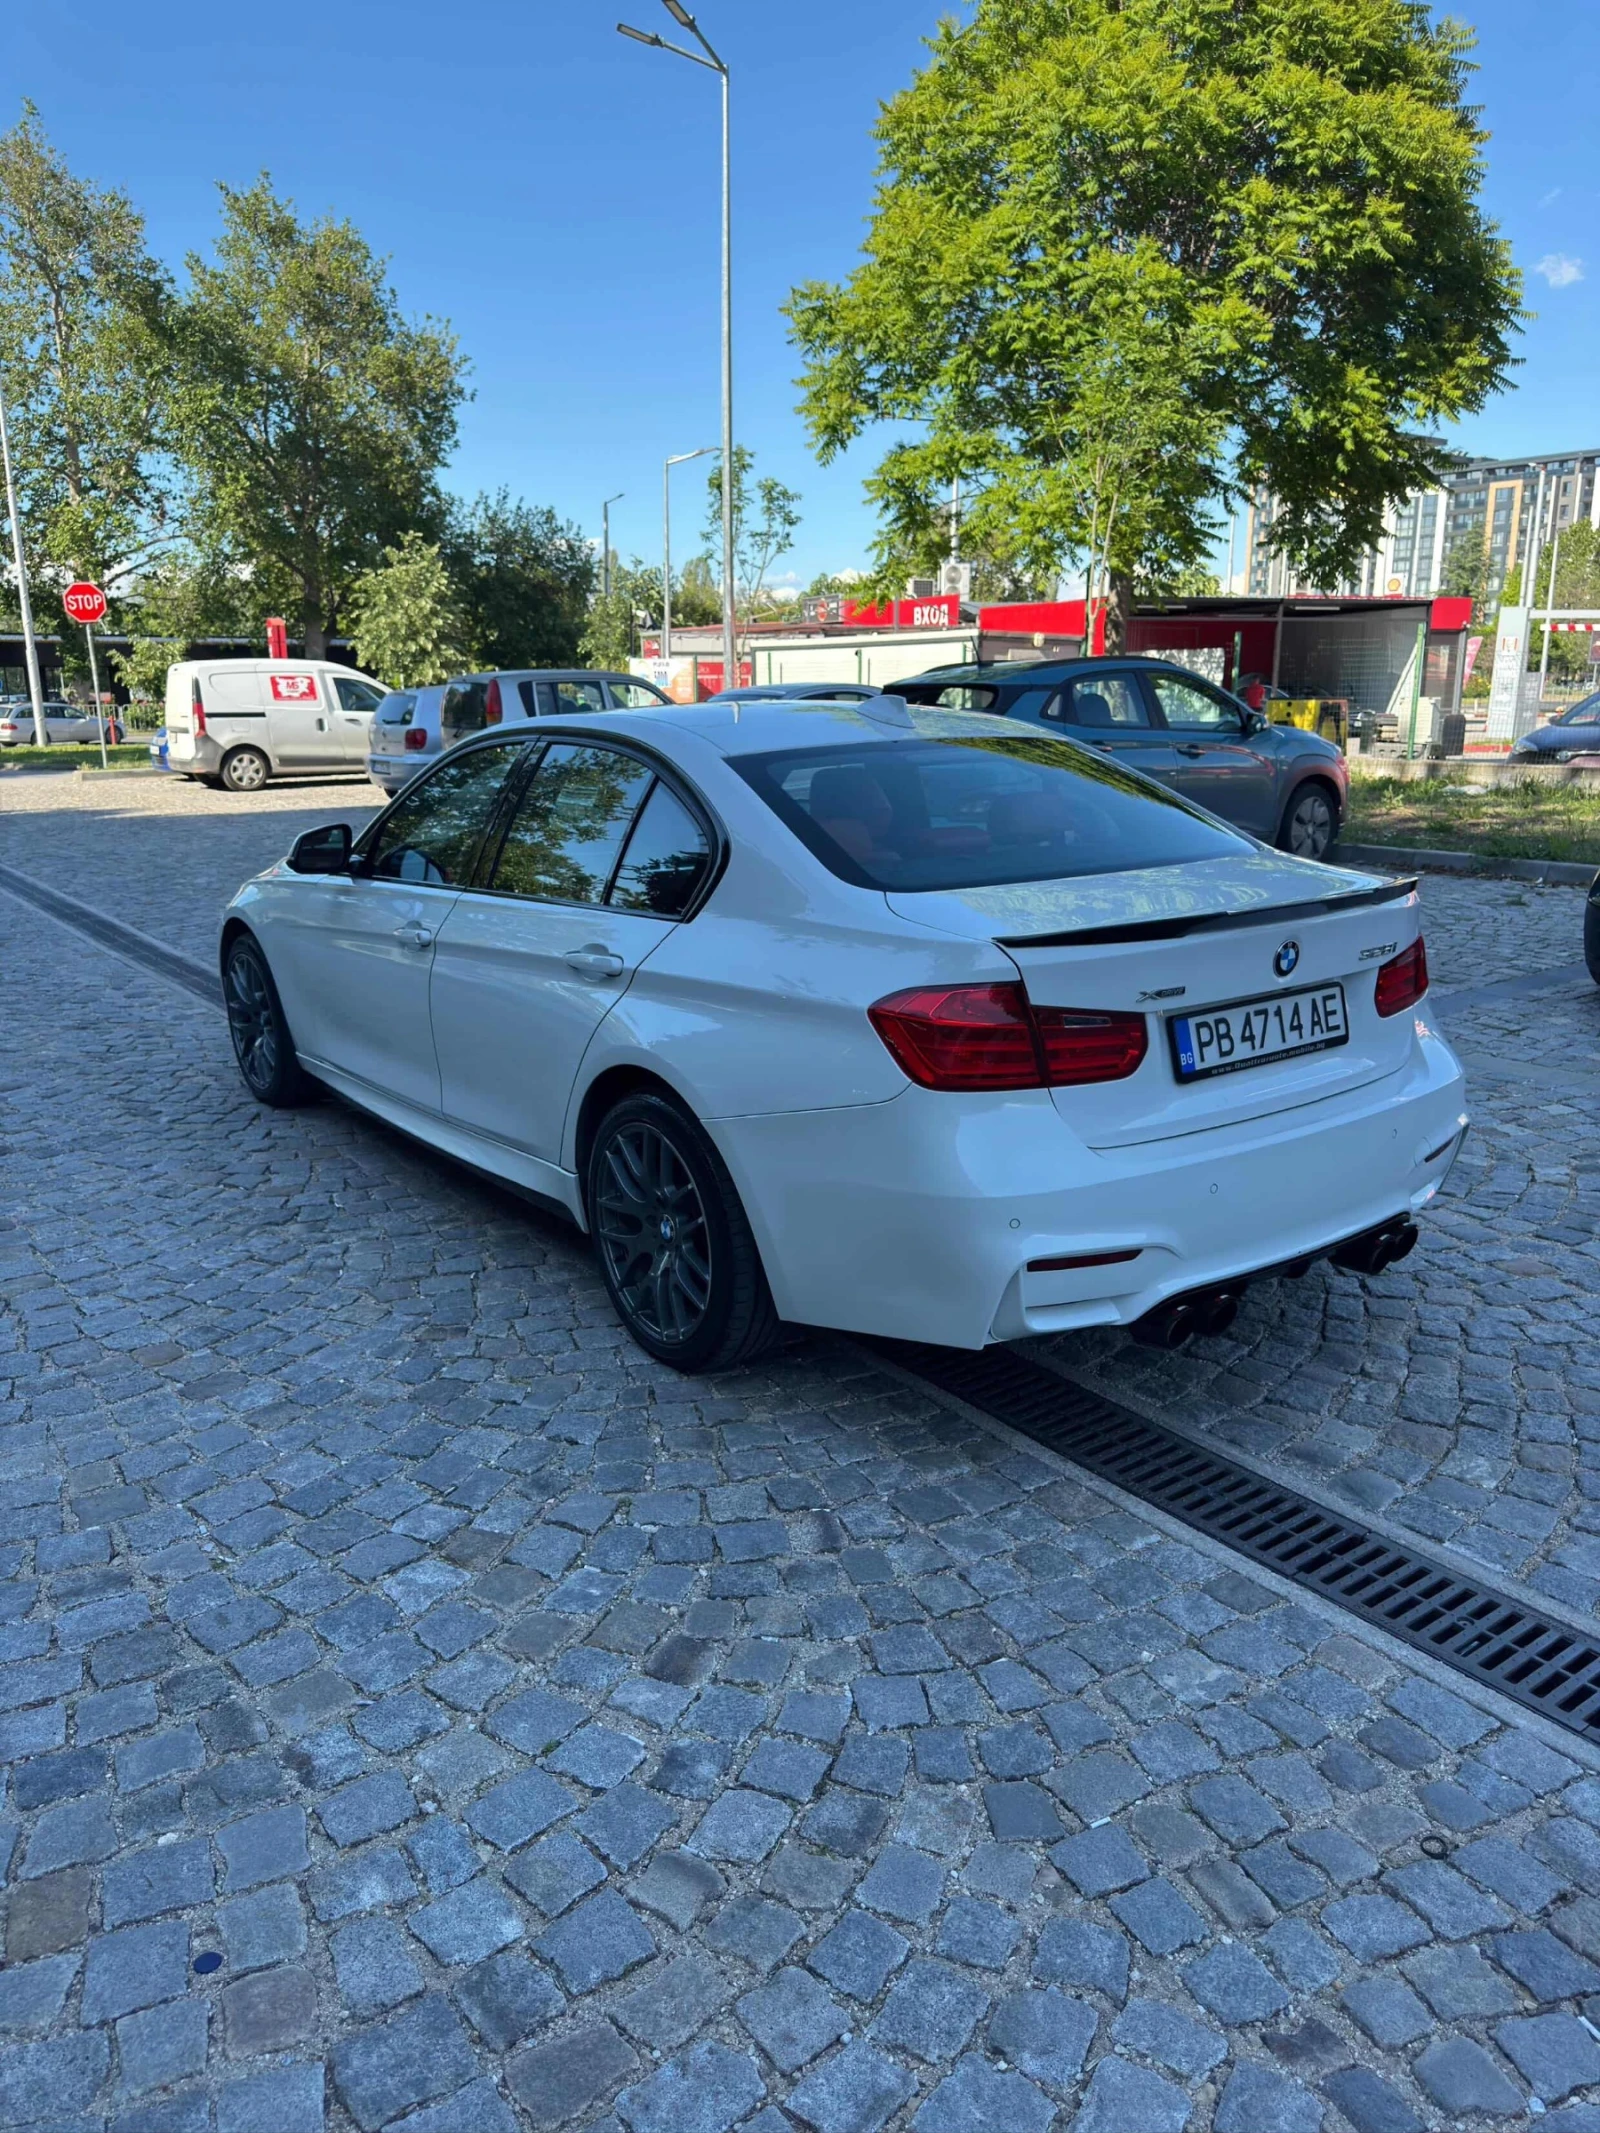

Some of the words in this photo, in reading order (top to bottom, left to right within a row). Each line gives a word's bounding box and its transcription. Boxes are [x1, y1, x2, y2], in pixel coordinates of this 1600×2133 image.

[66, 594, 102, 611] STOP
[913, 603, 949, 626] ВХОД
[1195, 1017, 1235, 1062] PB
[1240, 1001, 1304, 1051] 4714
[1310, 994, 1341, 1037] AE
[1180, 1052, 1194, 1066] BG
